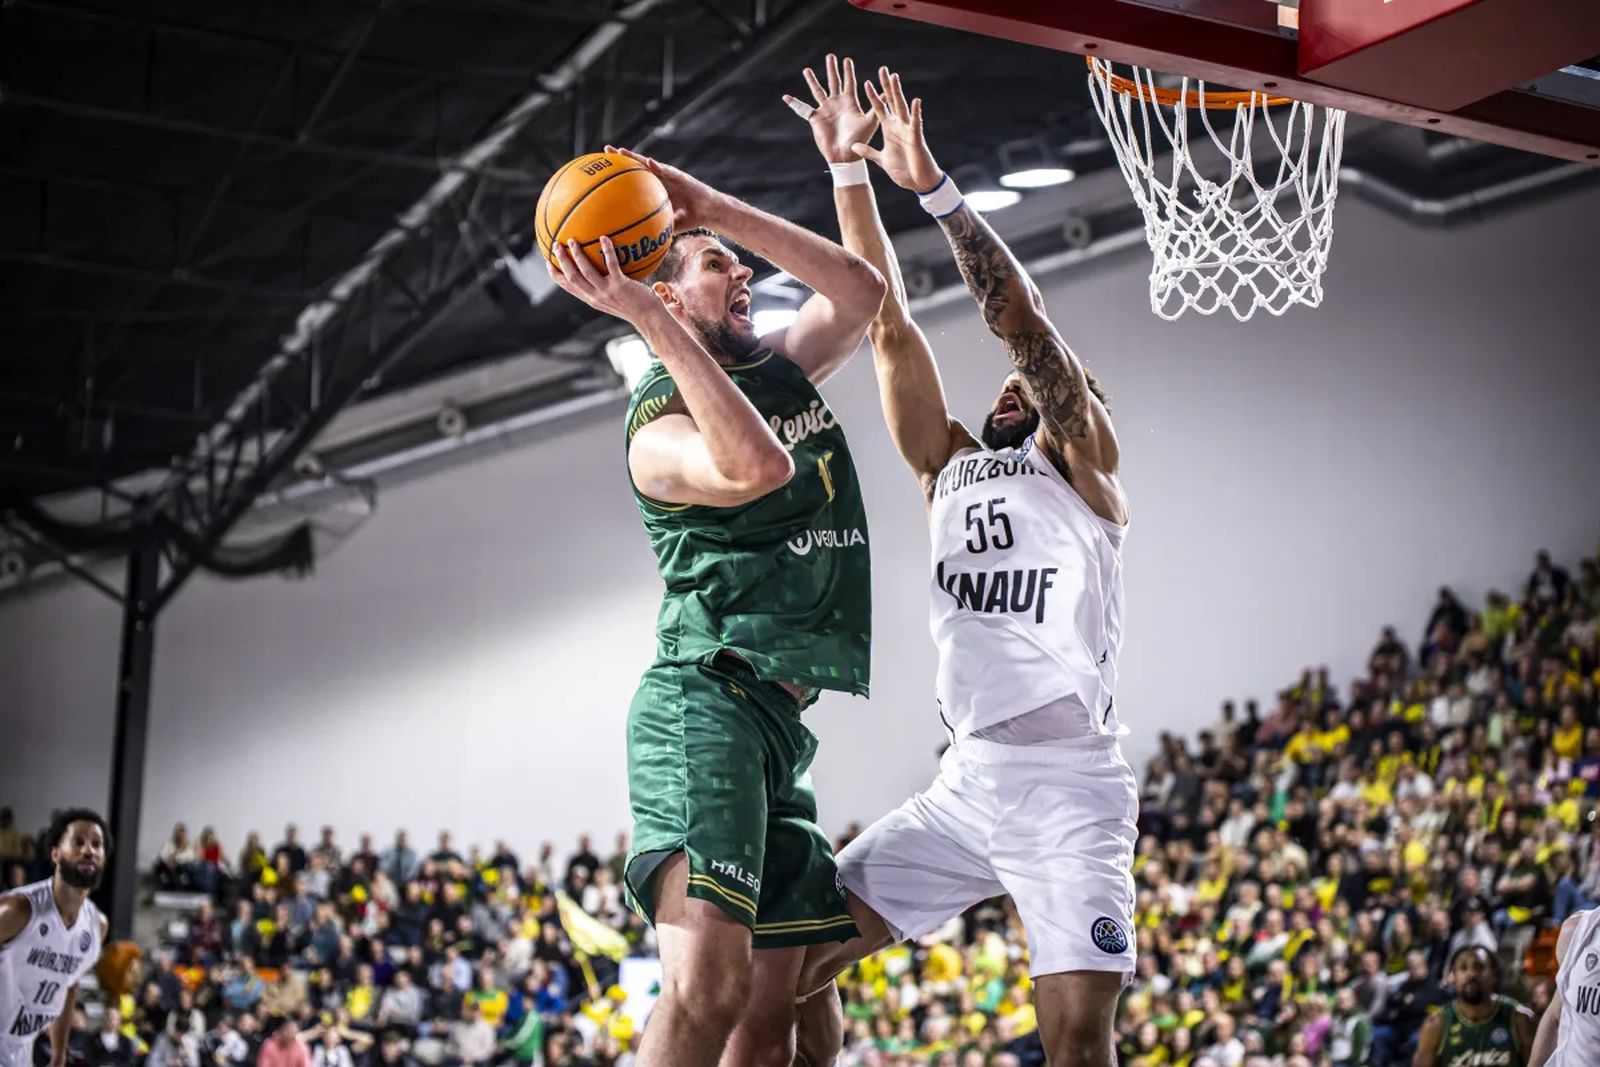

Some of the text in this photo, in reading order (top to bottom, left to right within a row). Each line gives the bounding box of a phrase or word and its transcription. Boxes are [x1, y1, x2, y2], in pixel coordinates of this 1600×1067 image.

[583, 158, 613, 176] FIBA
[812, 527, 866, 548] VEOLIA
[965, 497, 1015, 555] 55
[937, 561, 1058, 624] KNAUF
[711, 859, 760, 892] HALEO
[33, 979, 60, 1004] 10
